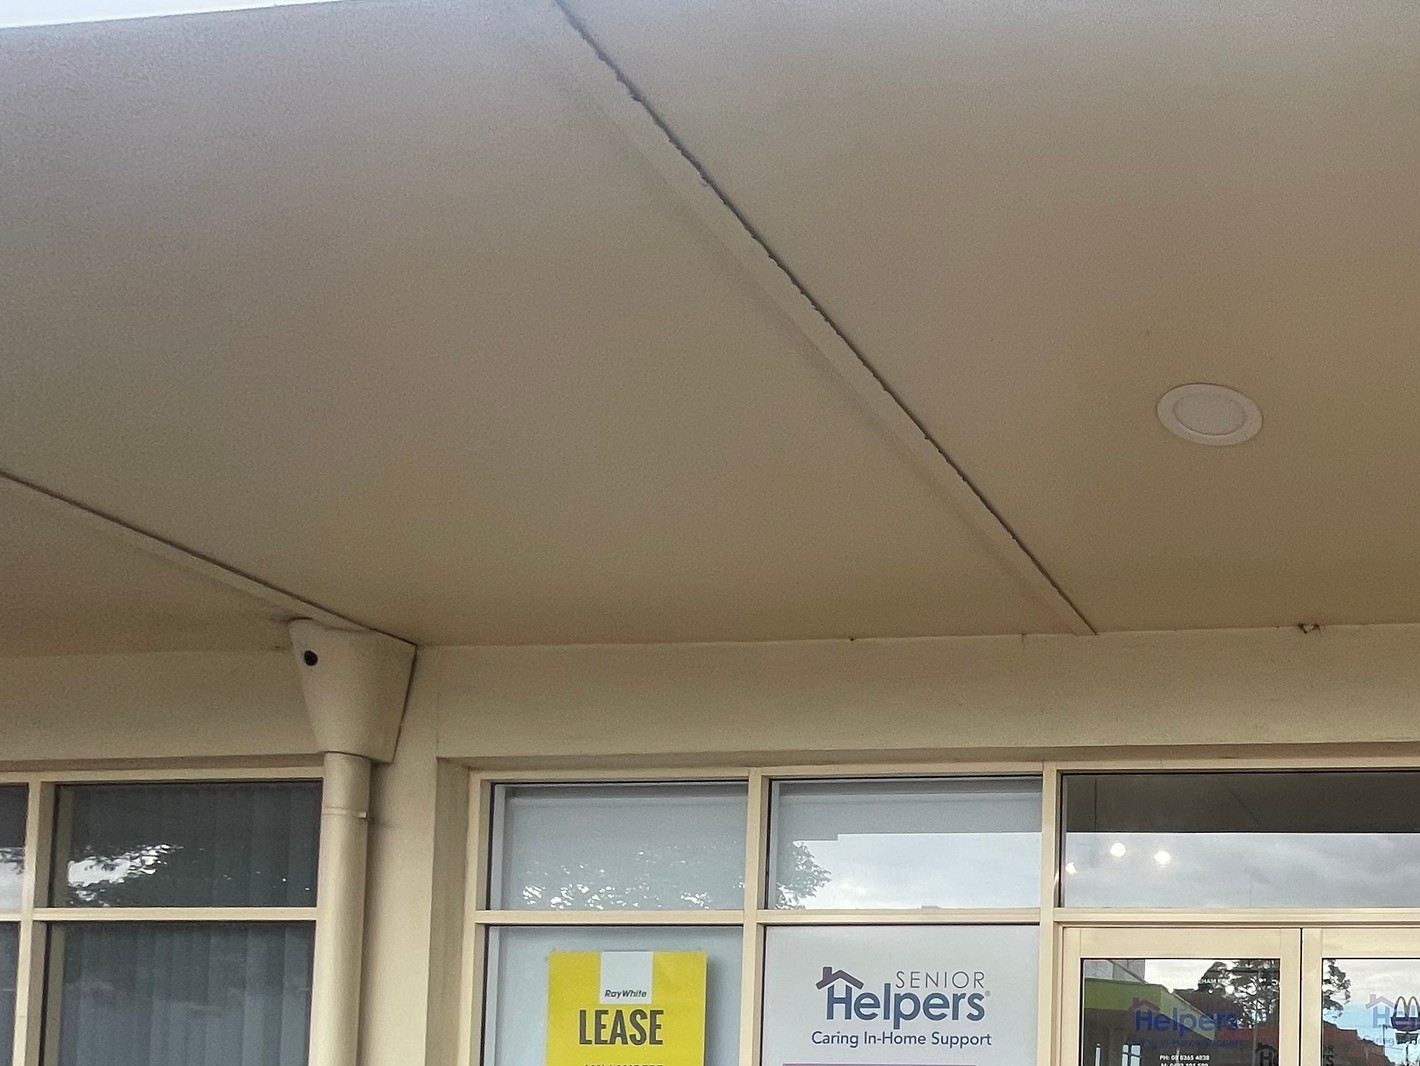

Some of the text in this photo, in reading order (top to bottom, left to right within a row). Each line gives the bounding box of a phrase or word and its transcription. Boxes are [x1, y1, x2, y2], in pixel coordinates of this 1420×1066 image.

[895, 971, 985, 989] SENIOR
[604, 989, 647, 999] RayWhite
[826, 982, 986, 1030] Helpers
[579, 1009, 664, 1045] LEASE
[1135, 1007, 1240, 1036] Helpers
[811, 1031, 992, 1049] Caring In-Home Support
